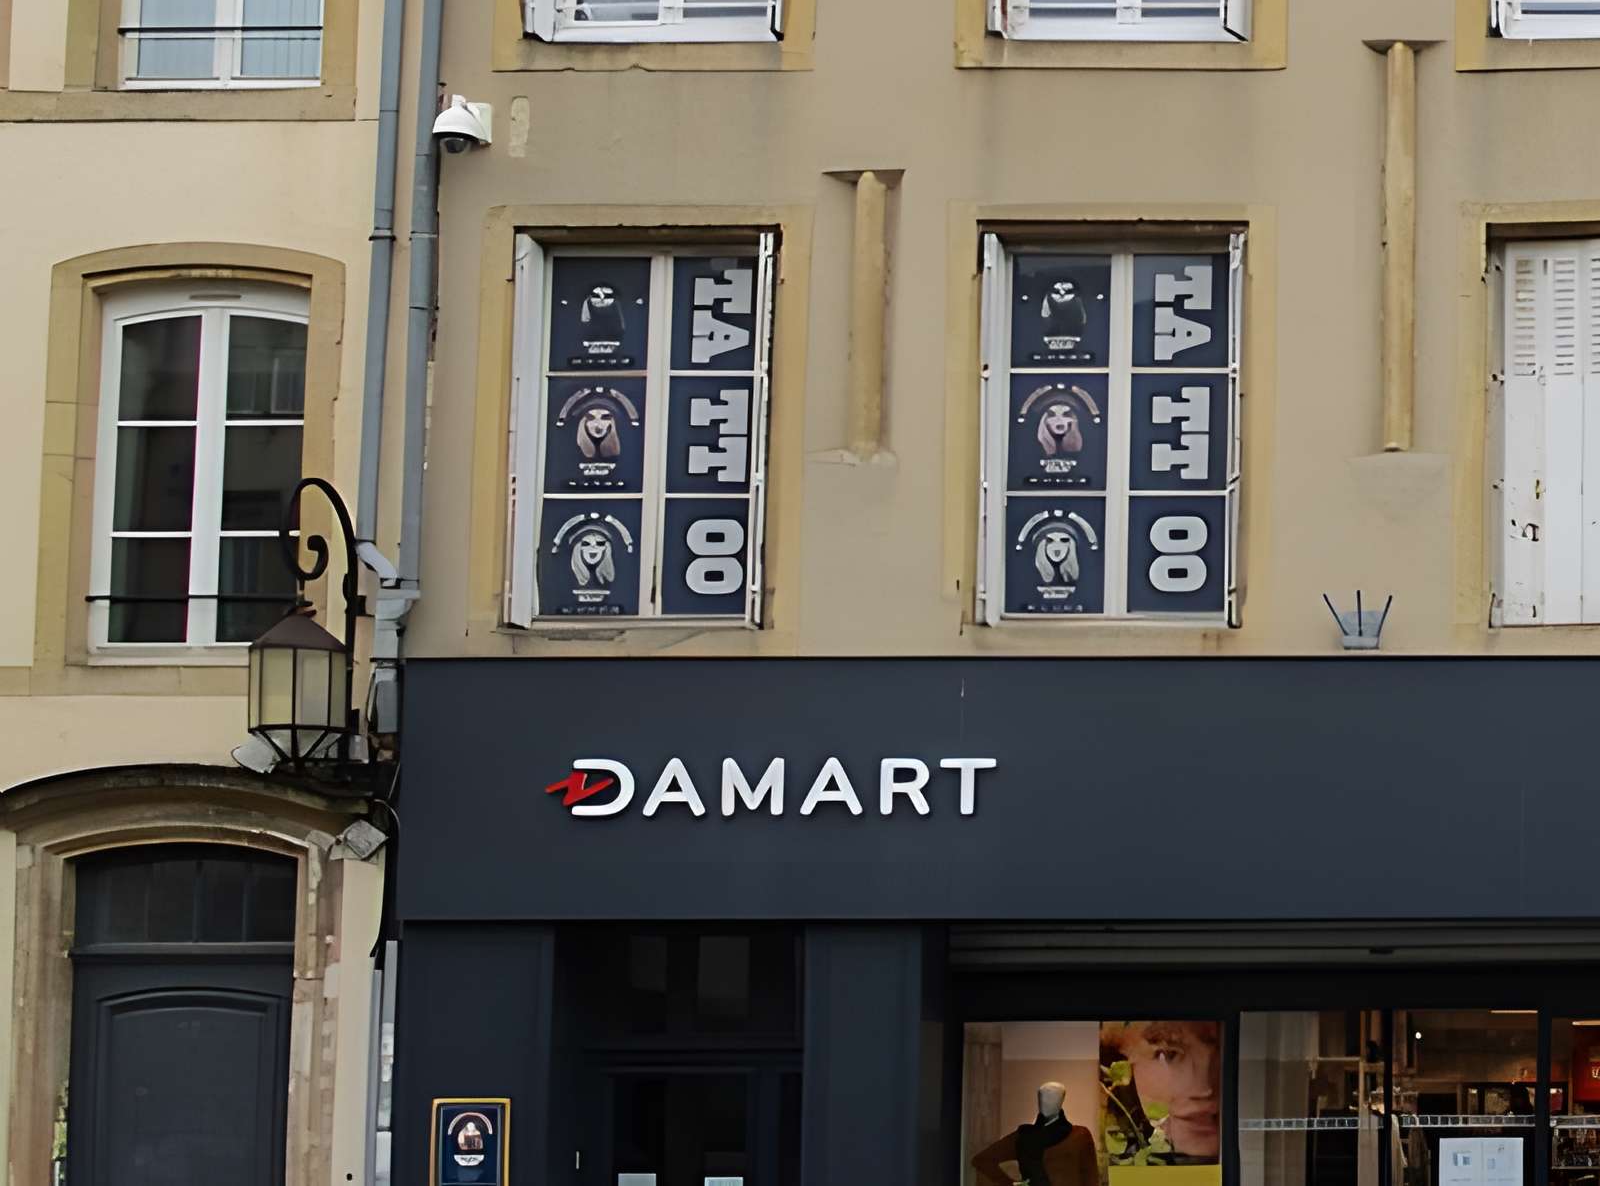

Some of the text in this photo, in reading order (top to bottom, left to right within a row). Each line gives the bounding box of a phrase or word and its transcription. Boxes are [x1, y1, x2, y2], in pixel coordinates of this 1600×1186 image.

[686, 269, 752, 595] TATTOO
[1149, 266, 1212, 592] TATTOO
[572, 757, 997, 817] DAMART
